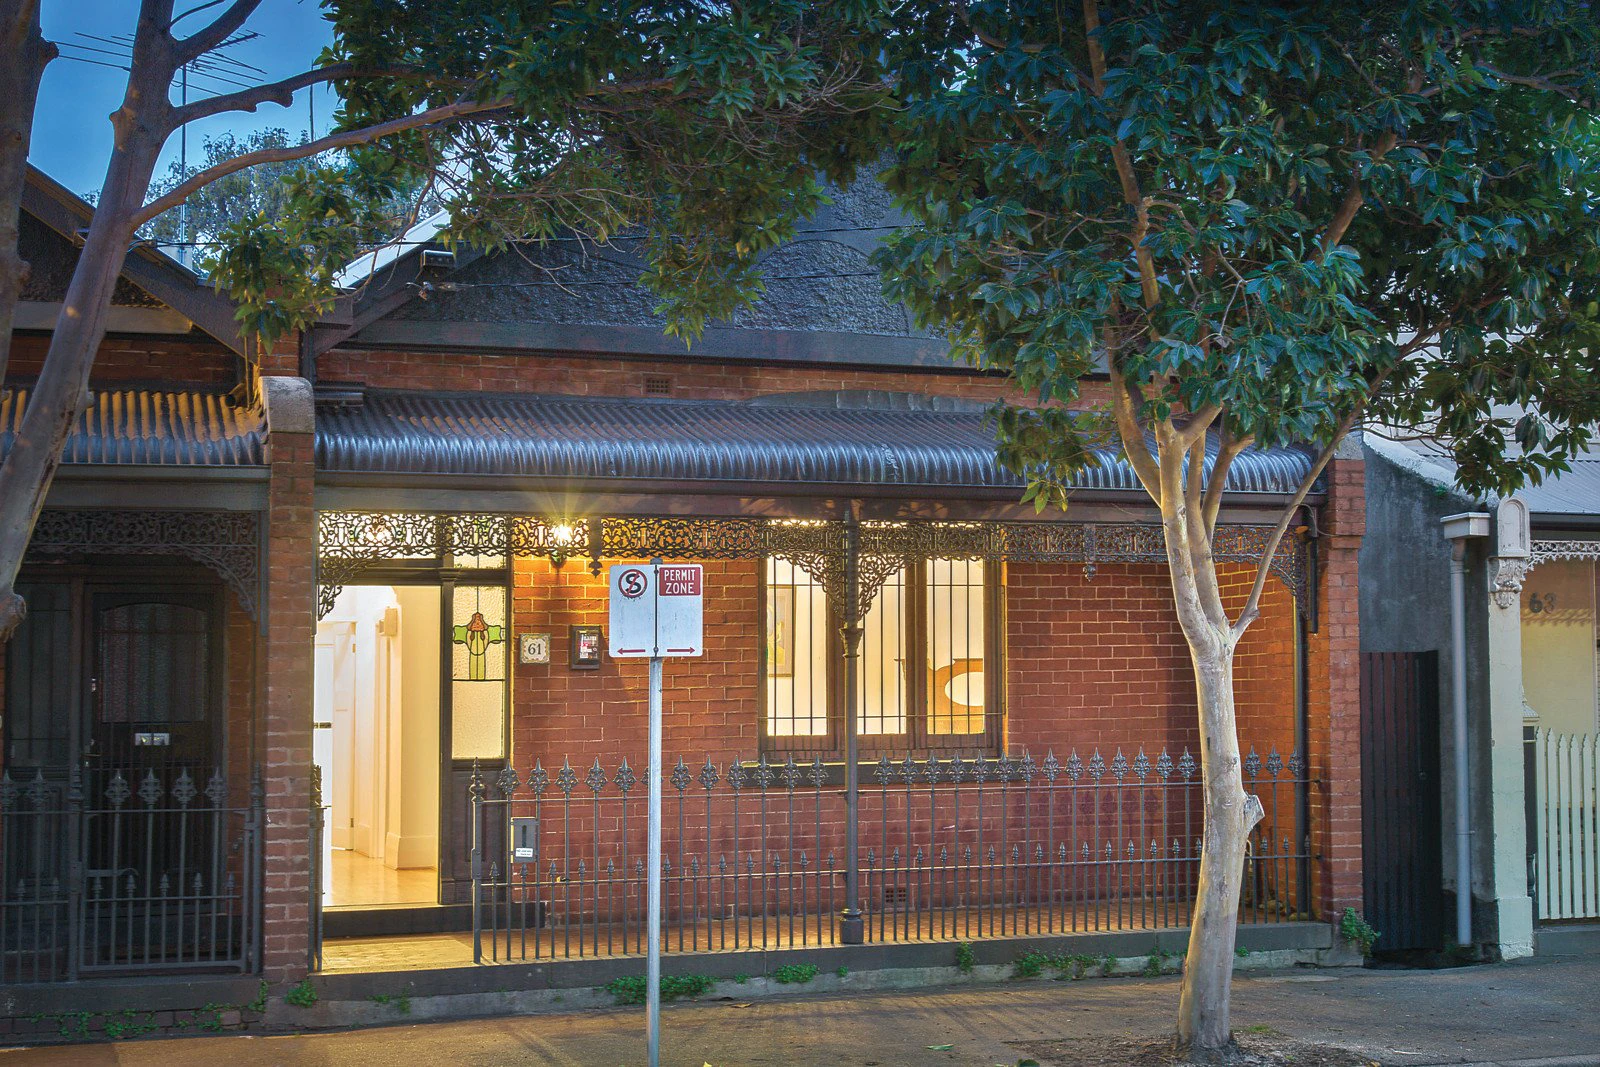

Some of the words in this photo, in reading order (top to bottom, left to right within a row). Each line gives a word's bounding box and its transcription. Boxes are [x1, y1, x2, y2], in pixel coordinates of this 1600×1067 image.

[664, 570, 695, 581] PERMIT
[666, 583, 694, 594] ZONE
[1530, 592, 1556, 614] 63
[528, 643, 541, 655] 61
